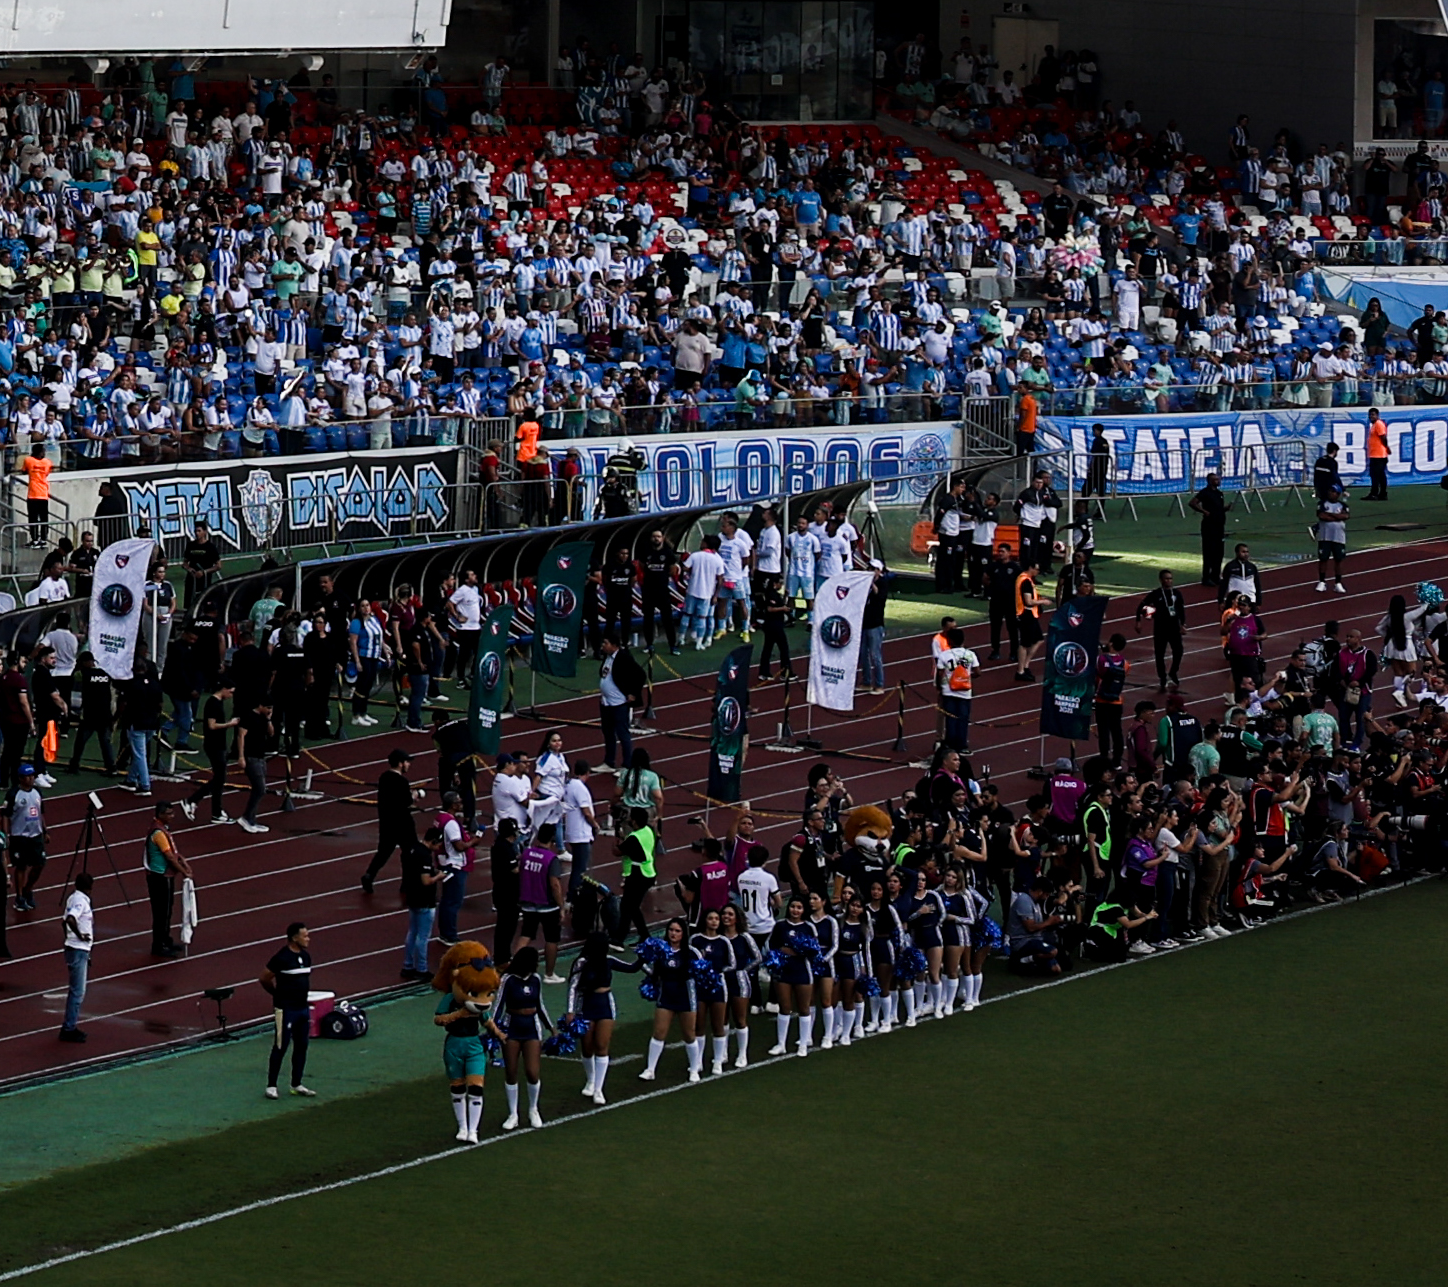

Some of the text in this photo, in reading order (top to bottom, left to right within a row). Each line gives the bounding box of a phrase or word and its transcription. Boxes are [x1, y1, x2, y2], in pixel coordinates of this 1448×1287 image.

[1333, 420, 1448, 478] BCO
[121, 476, 241, 549] METAL
[287, 463, 450, 534] BICOLOR
[741, 888, 758, 914] 01
